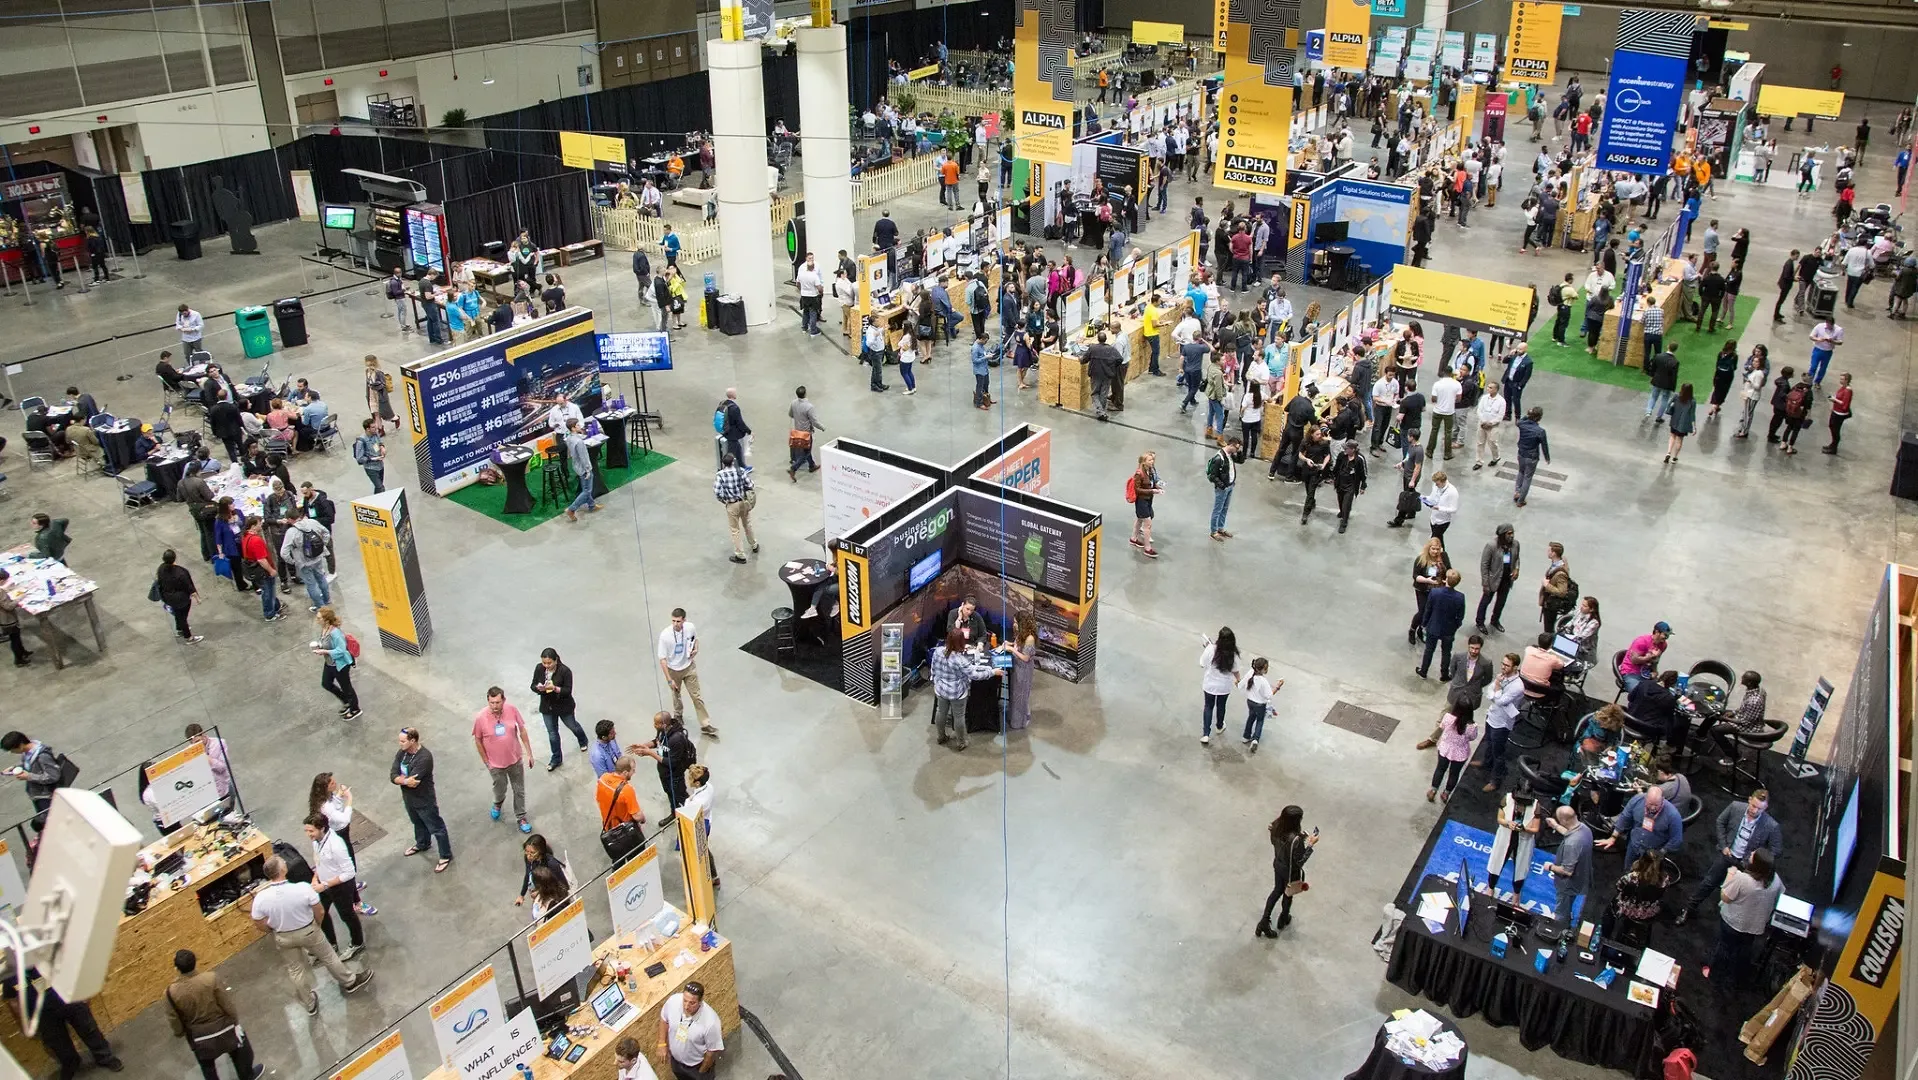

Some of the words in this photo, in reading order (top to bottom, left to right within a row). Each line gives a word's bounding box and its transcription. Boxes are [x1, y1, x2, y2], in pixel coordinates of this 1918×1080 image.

[1313, 38, 1320, 49] 2
[1332, 34, 1361, 43] ALPHA
[1514, 59, 1546, 69] ALPHA
[1025, 112, 1063, 128] ALPHA
[1227, 156, 1274, 173] ALPHA
[1358, 188, 1380, 196] Solutions
[1381, 191, 1404, 200] Delivered
[1295, 203, 1304, 238] COLLISION
[430, 368, 460, 389] 25%
[433, 390, 448, 402] LOW
[434, 398, 450, 408] HIGH
[481, 395, 496, 410] #1
[436, 411, 452, 426] #1
[485, 416, 502, 432] #6
[440, 434, 459, 450] #5
[443, 456, 464, 468] READY
[475, 445, 492, 455] MOVE
[493, 440, 501, 449] TO
[503, 434, 517, 445] NEW
[518, 422, 546, 437] ORLEANS?
[842, 466, 871, 478] NOMINET
[1006, 456, 1024, 475] MEET
[356, 506, 378, 517] Startup
[357, 513, 385, 527] Directory
[905, 508, 954, 548] oregon
[894, 518, 927, 545] business
[1021, 520, 1039, 530] GLOBAL
[1040, 525, 1062, 537] GATEWAY
[1086, 540, 1095, 598] COLLISION
[847, 560, 860, 624] COLLISION
[1860, 897, 1905, 983] COLLISION
[510, 1028, 520, 1040] IS
[464, 1046, 495, 1073] WHAT
[478, 1037, 538, 1080] INFLUENCE?
